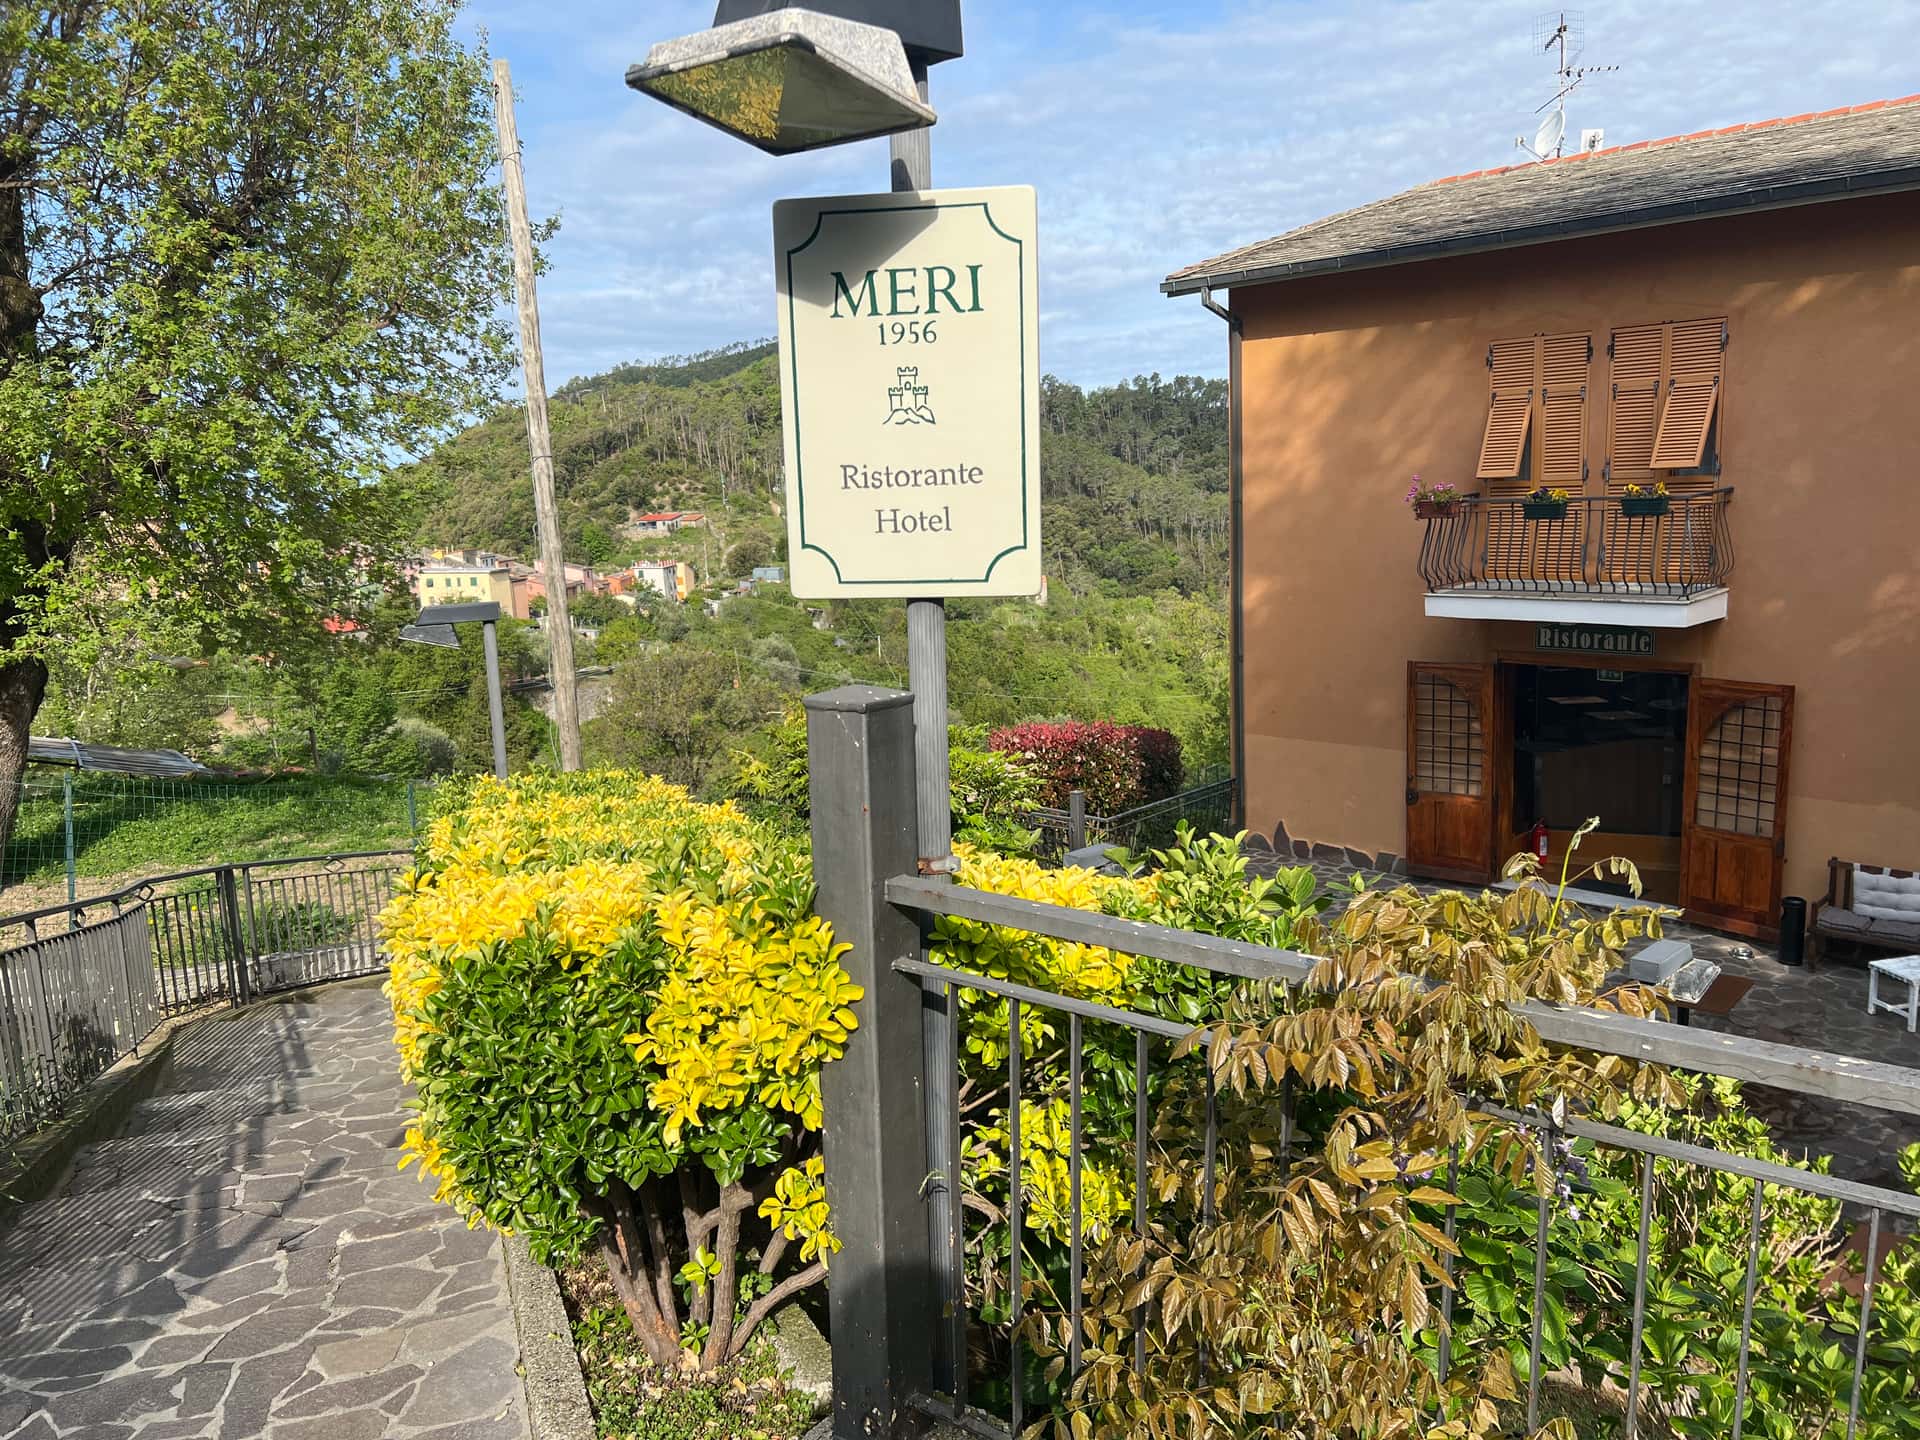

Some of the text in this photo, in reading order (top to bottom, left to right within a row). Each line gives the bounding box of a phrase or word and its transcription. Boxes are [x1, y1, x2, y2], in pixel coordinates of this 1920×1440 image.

[830, 264, 984, 319] MERI
[878, 319, 938, 346] 1956
[840, 462, 984, 490] Ristorante
[874, 506, 953, 534] Hotel
[1539, 627, 1650, 651] Ristorante
